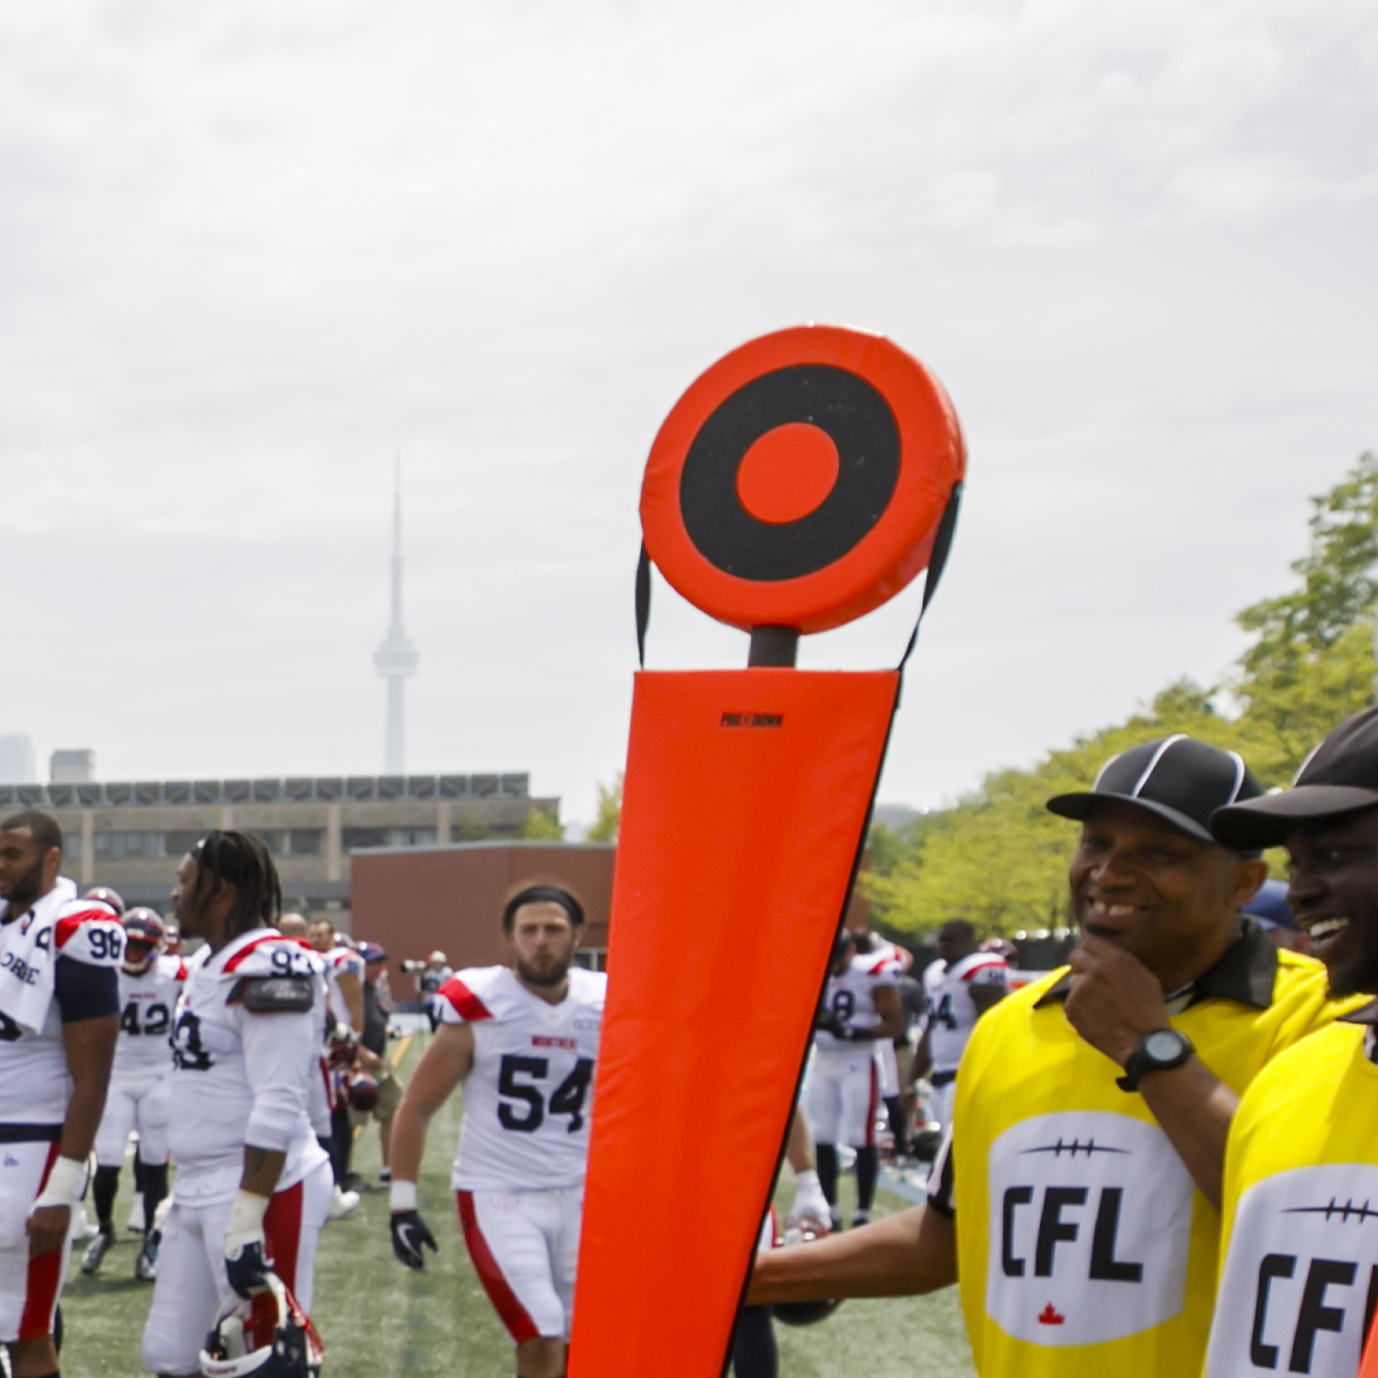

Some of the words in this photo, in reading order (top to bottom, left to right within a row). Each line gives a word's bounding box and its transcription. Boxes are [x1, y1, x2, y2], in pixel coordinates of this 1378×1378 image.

[120, 1001, 171, 1036] 42
[497, 1054, 595, 1134] 54
[1002, 1185, 1144, 1283] CFL
